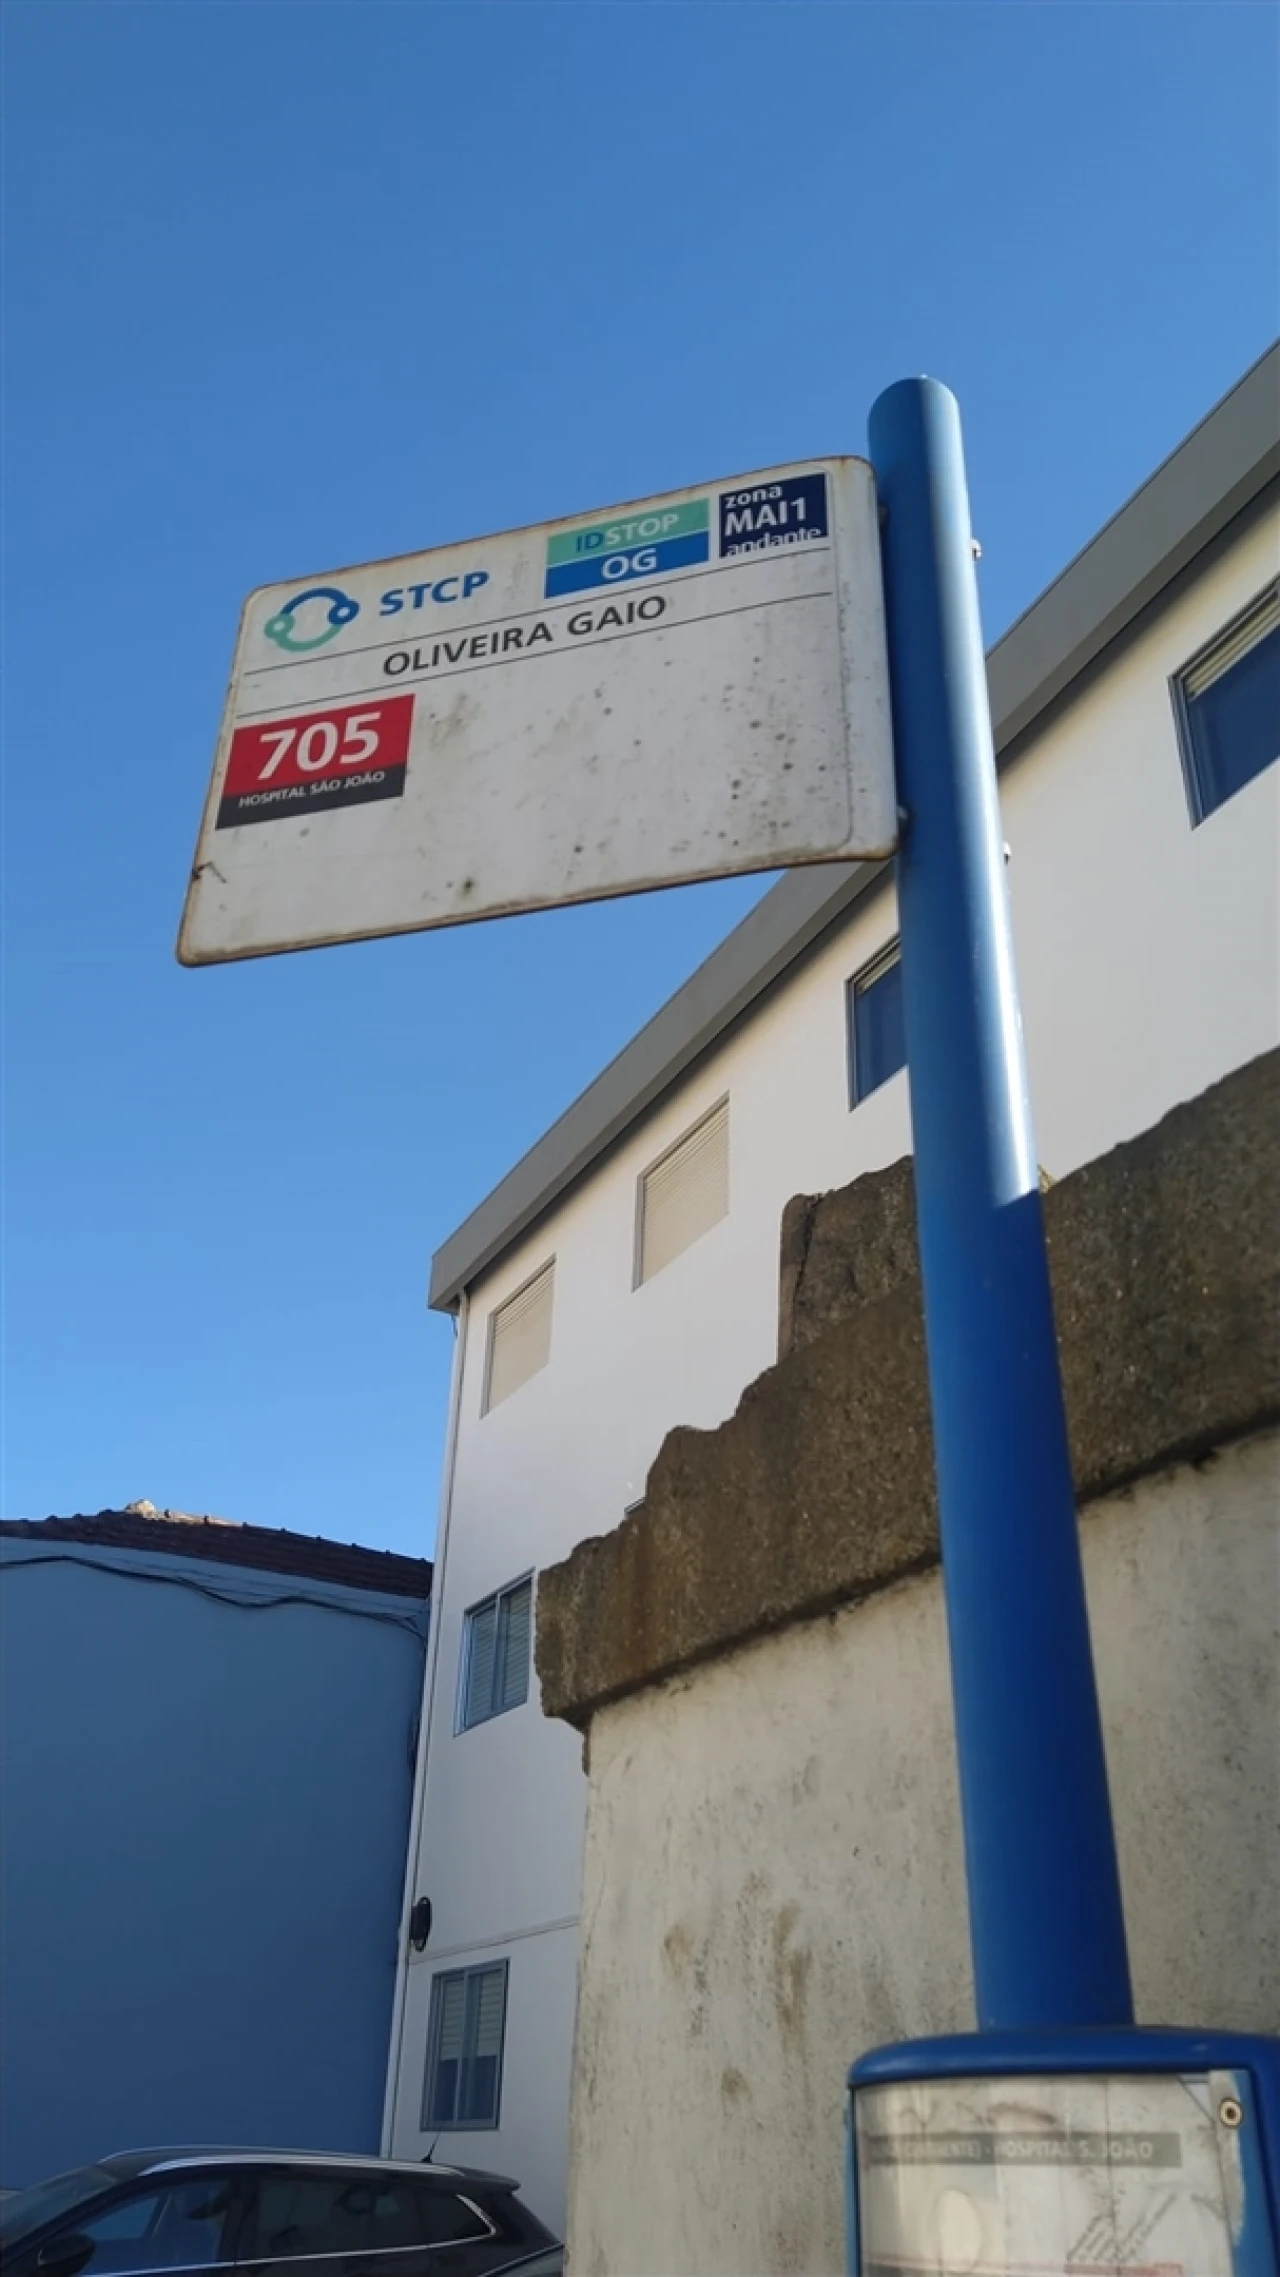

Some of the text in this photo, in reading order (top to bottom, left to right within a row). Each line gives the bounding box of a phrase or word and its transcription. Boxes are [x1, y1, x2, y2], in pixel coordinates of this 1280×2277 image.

[725, 485, 783, 509] zona
[602, 547, 657, 580] OG
[379, 571, 489, 616] STCP
[383, 595, 667, 676] OLIVEIRA GAIO
[257, 711, 382, 780] 705
[238, 770, 386, 808] HOSPITAL SÃO JOÃO
